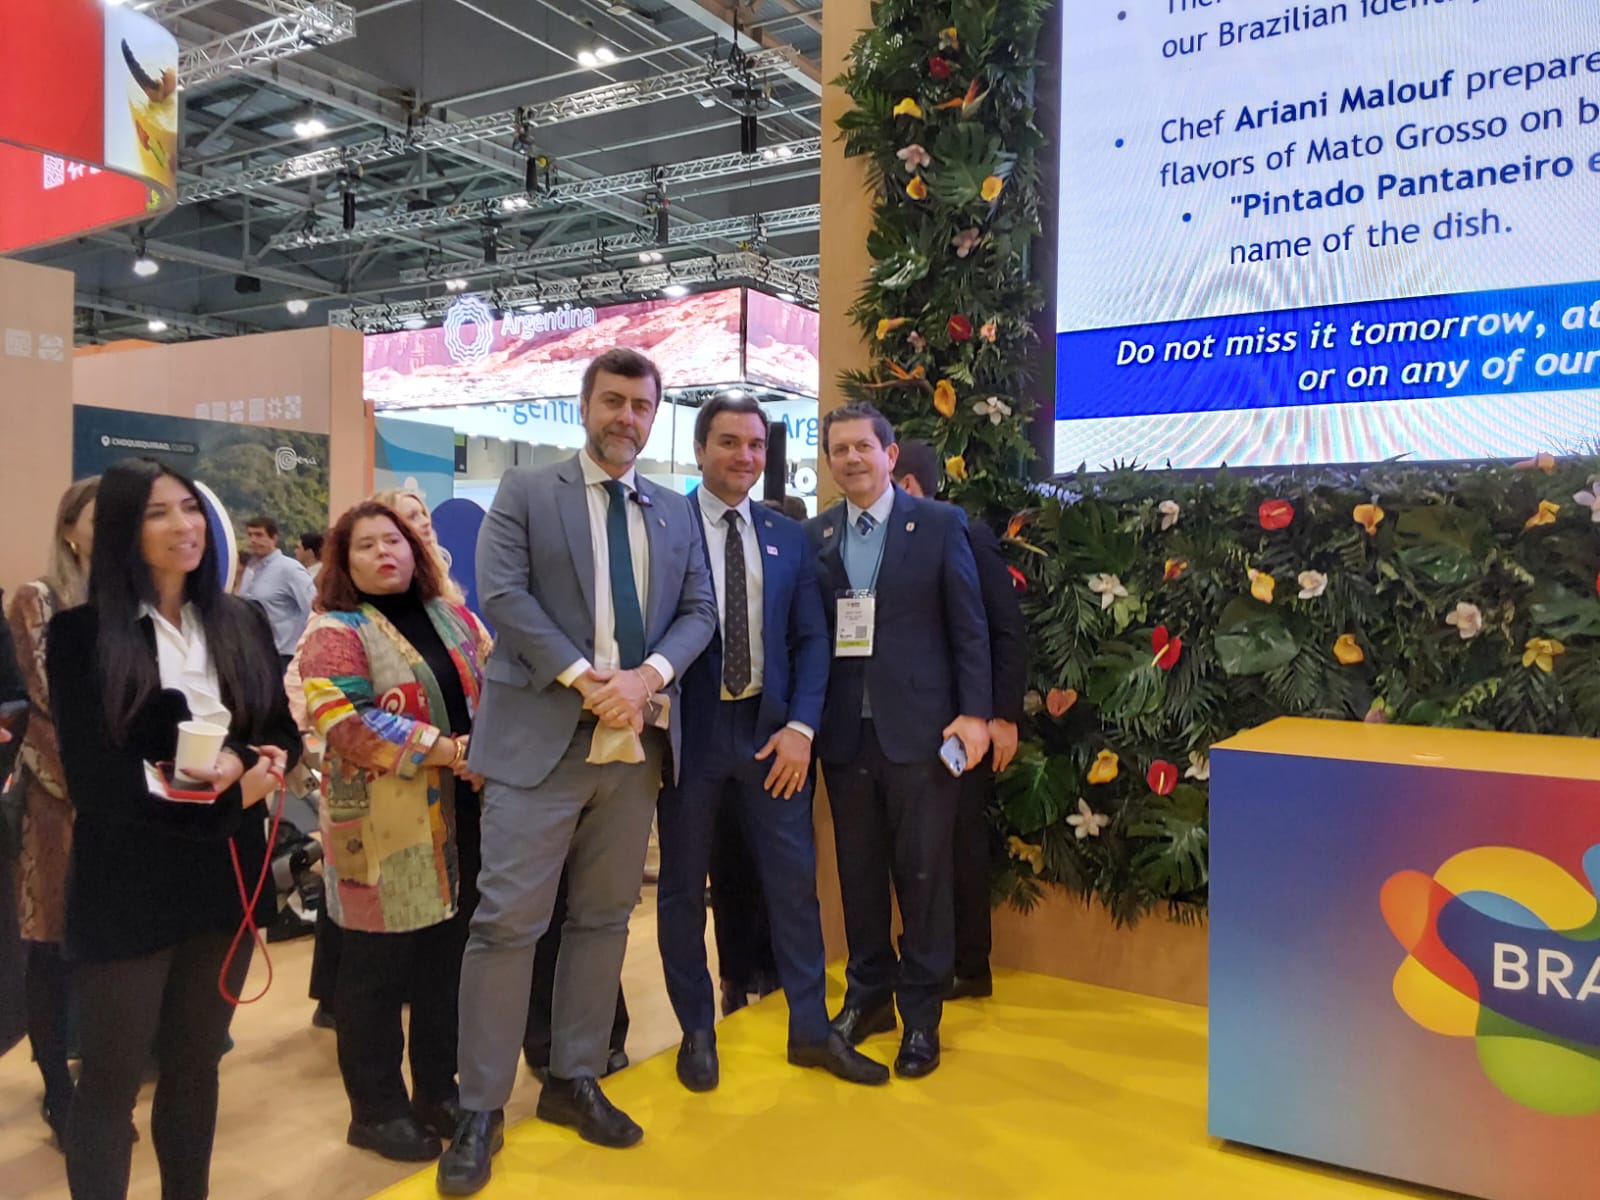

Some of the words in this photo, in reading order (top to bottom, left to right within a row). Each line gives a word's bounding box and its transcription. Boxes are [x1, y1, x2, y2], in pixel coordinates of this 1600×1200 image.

[1162, 30, 1208, 58] our
[1219, 4, 1347, 47] Brazilian
[1160, 110, 1224, 144] Chef
[1234, 91, 1328, 132] Ariani
[1340, 69, 1455, 112] Malouf
[1160, 155, 1255, 187] flavors
[1266, 142, 1296, 171] of
[1306, 131, 1383, 165] Mato
[1395, 115, 1507, 150] Grosso
[1520, 110, 1562, 133] on
[1230, 180, 1365, 218] "Pintado
[1377, 153, 1574, 200] Pantaneiro
[1230, 240, 1311, 264] name
[1322, 225, 1354, 254] of
[1367, 220, 1420, 246] the
[1432, 209, 1513, 239] dish.
[501, 303, 596, 340] Argentina
[1116, 341, 1155, 365] Do
[1163, 332, 1216, 363] not
[1224, 326, 1297, 356] miss
[1308, 322, 1337, 350] it
[1349, 309, 1546, 345] tomorrow,
[1298, 369, 1333, 391] or
[1346, 364, 1388, 386] on
[1401, 359, 1470, 389] any
[1481, 348, 1526, 385] of
